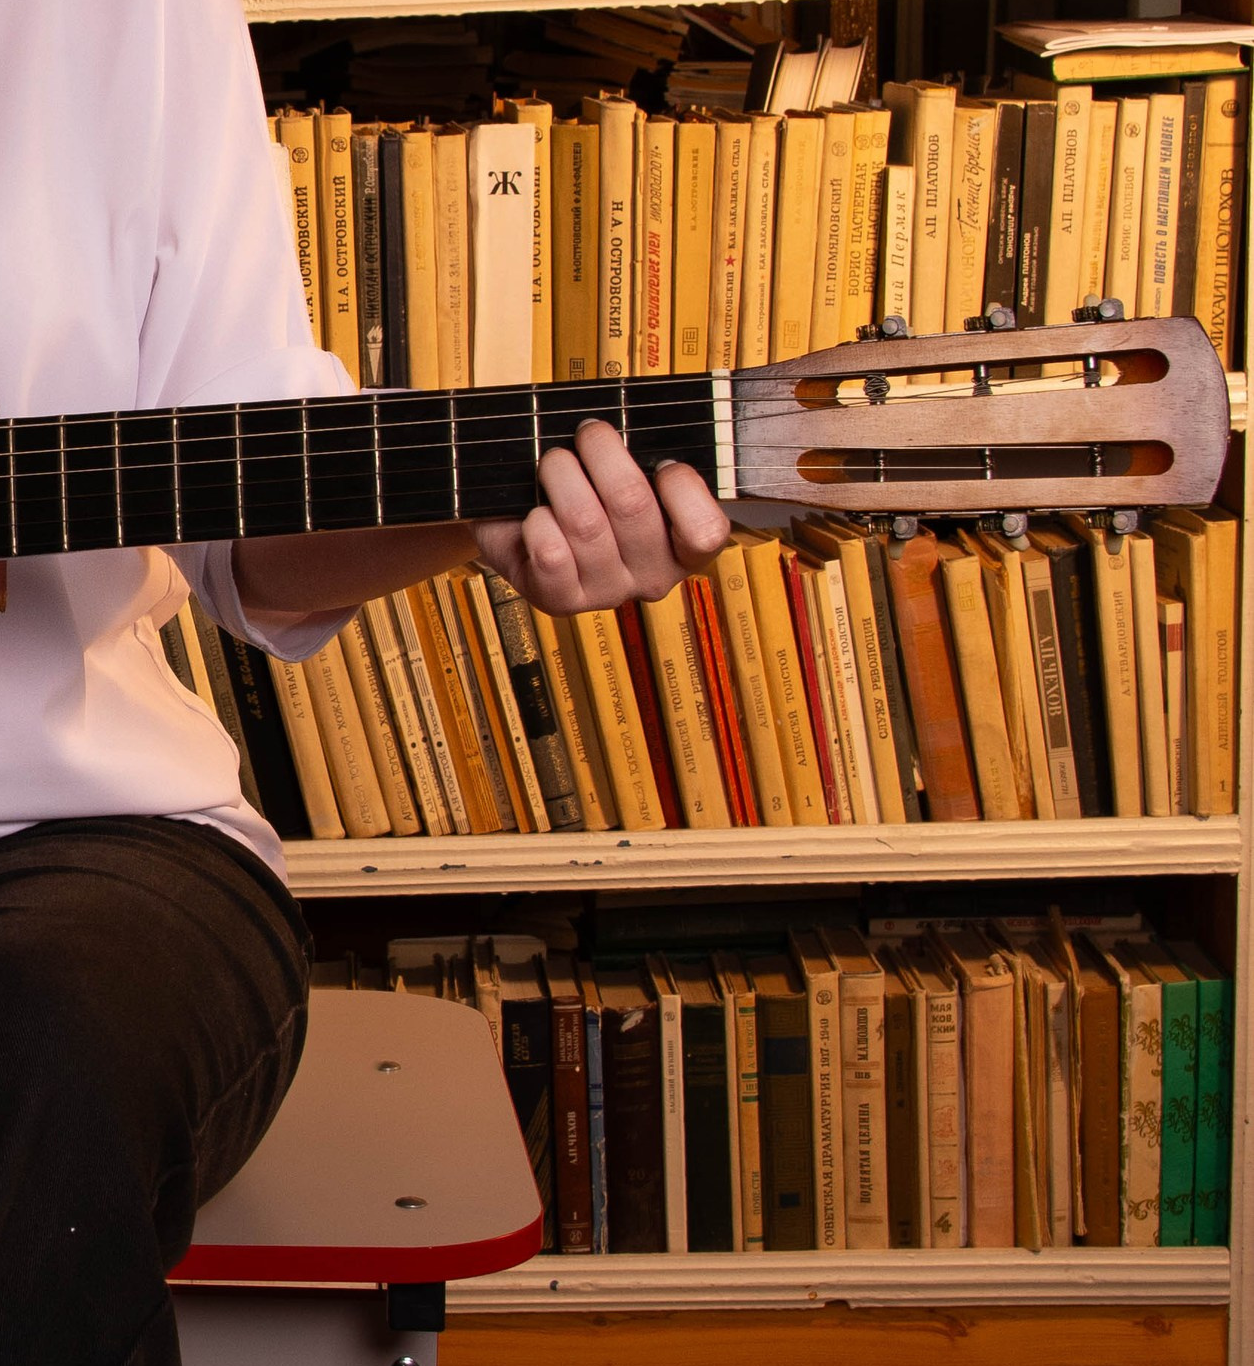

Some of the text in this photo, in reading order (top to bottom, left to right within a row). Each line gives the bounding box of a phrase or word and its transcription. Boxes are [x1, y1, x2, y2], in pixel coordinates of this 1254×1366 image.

[731, 139, 740, 166] СТАЛЬ
[1063, 130, 1077, 202] ПЛАТОНОВ
[1159, 116, 1174, 162] ЧЕЛОВЕКЕ
[488, 172, 522, 195] Ж
[729, 169, 739, 228] ЗАКАЛЯЛАСЬ
[927, 135, 939, 208] ПЛАТОНОВ
[1156, 168, 1171, 226] НАСТОЯЩЕМ
[333, 175, 347, 277] ОСТРОВСКИЙ
[728, 231, 736, 249] КАК
[827, 178, 842, 281] ПОМЯЛОВСКИЙ
[849, 163, 867, 296] БОРИС ПАСТЕРНАК
[891, 190, 907, 266] Пермяк
[1121, 167, 1134, 260] БОРИС ПОЛЕВОЙ
[609, 237, 622, 338] ОСТРОВСКИЙ
[1021, 233, 1031, 306] Андрей ПЛАТОНОВ
[1154, 240, 1167, 284] ПОВЕСТЬ
[1211, 169, 1234, 350] МИХАИЛ ШОЛОХОВ
[724, 271, 735, 337] ОСТРОВСКИЙ
[835, 606, 849, 654] ТОЛСТОЙ
[1217, 630, 1227, 685] ТОЛСТОЙ
[552, 648, 572, 702] ТОЛСТОЙ
[777, 649, 794, 703] ТОЛСТОЙ
[862, 617, 888, 739] СЛУЖУ РЕВОЛЮЦИИ
[568, 710, 589, 763] АЛЕКСЕЙ
[789, 711, 807, 767] АЛЕКСЕЙ
[1217, 692, 1229, 750] АЛЕКСЕЙ
[820, 1073, 833, 1167] ДРАМАТУРГИЯ
[859, 1103, 870, 1144] ЦЕЛИНА
[859, 1150, 872, 1203] ПОДНЯТАЯ
[823, 1173, 834, 1246] СОВЕТСКАЯ
